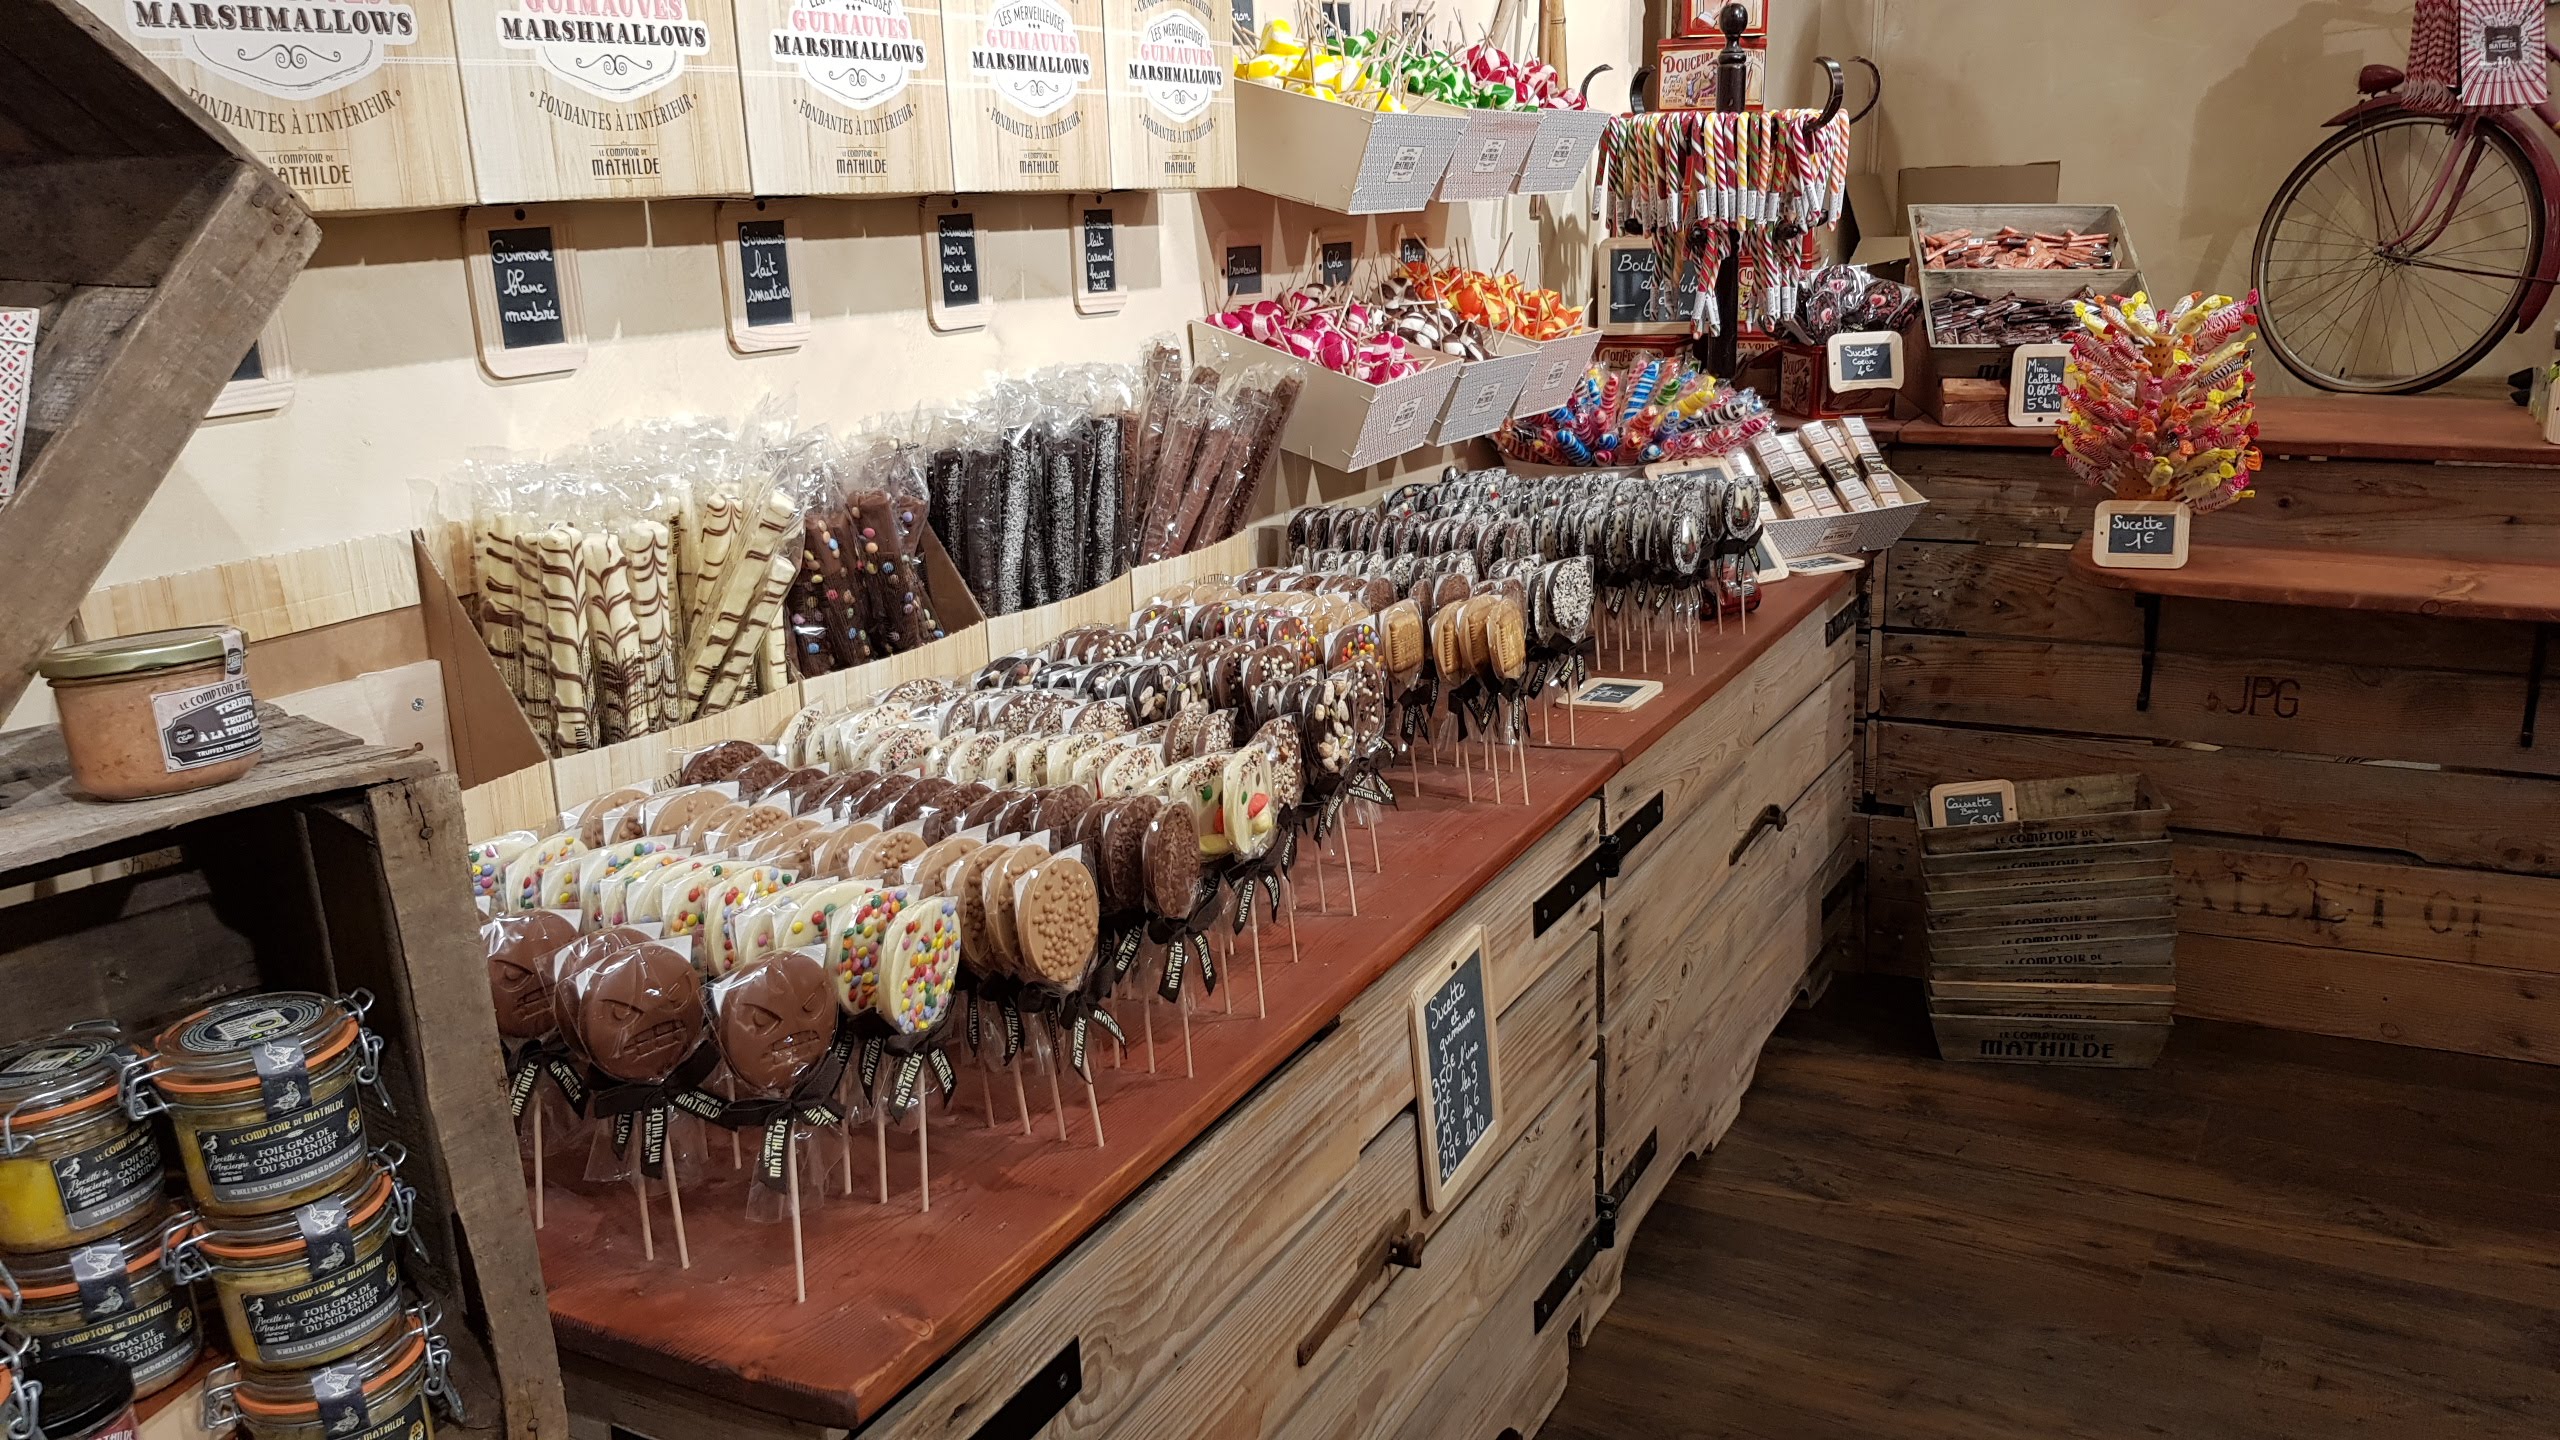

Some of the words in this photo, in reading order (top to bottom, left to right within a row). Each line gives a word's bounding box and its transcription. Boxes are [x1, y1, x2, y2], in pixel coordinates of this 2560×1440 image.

[136, 1, 413, 36] MARSHMALLOWS
[502, 17, 707, 47] MARSHMALLOWS
[793, 10, 908, 39] GUIMAUVES
[999, 10, 1012, 27] LES
[1013, 5, 1064, 33] MERVEILLEUSES
[774, 35, 924, 63] MARSHMALLOWS
[987, 29, 1077, 54] GUIMAUVES
[1151, 24, 1162, 42] LES
[1163, 23, 1203, 48] MERVEILLEUSES
[972, 51, 1089, 75] MARSHMALLOWS
[1141, 44, 1213, 67] GUIMAUVES
[1129, 64, 1222, 86] MARSHMALLOWS
[291, 107, 302, 135] À
[307, 89, 397, 135] L'INTÉRIEUR
[538, 91, 612, 131] FONDANTES
[616, 109, 623, 131] À
[627, 94, 693, 131] L'INTÉRIEUR
[799, 99, 853, 136] FONDANTES
[864, 103, 914, 136] L'INTÉRIEUR
[991, 107, 1033, 140] FONDANTES
[1041, 111, 1081, 140] L'INTÉRIEUR
[1143, 114, 1176, 143] FONDANTES
[278, 153, 323, 165] COMPTOIR
[592, 158, 660, 176] MATHILDE
[837, 159, 887, 174] MATHILDE
[1020, 161, 1059, 174] MATHILDE
[1165, 162, 1196, 174] MATHILDE
[271, 164, 352, 185] ATHILDE
[1087, 232, 1104, 247] lait
[750, 249, 778, 278] lait
[1326, 250, 1343, 269] Cola
[503, 269, 547, 296] blanc
[747, 278, 791, 303] smarties
[505, 299, 560, 323] marbré
[1844, 345, 1879, 357] Sucette
[1857, 365, 1874, 376] 4€
[2028, 358, 2048, 373] Mini
[2112, 514, 2167, 530] Sucette
[2125, 531, 2155, 549] 1€
[190, 683, 234, 707] COMPTOIR
[2226, 675, 2300, 718] JPG
[210, 730, 225, 740] LA
[1946, 796, 1993, 809] Caissette
[2010, 830, 2077, 844] COMPTOIR
[1116, 925, 1142, 971] MATHILDE
[1195, 934, 1213, 980] MATHILDE
[1169, 941, 1183, 989] MATHILDE
[1430, 981, 1466, 1030] Sucette
[1451, 1010, 1462, 1026] et
[1074, 1017, 1086, 1067] MATHILDE
[1439, 1008, 1476, 1066] guimauve
[1981, 1039, 2114, 1059] MATHILDE
[2013, 1031, 2079, 1041] COMPTOIR
[550, 1060, 581, 1104] MATHILDE
[895, 1051, 924, 1107] MATHILDE
[931, 1048, 953, 1093] MATHILDE
[1460, 1070, 1471, 1092] les
[1471, 1060, 1478, 1085] 3
[512, 1061, 539, 1116] MATHILDE
[1463, 1096, 1473, 1120] les
[1473, 1083, 1480, 1105] 6
[675, 1093, 720, 1119] MATHILD
[231, 1138, 239, 1146] LE
[240, 1120, 291, 1144] COMPTOIR
[303, 1098, 345, 1123] MATHILDE
[649, 1107, 664, 1163] MATHILDE
[1465, 1123, 1477, 1146] les
[1476, 1112, 1484, 1137] 10
[253, 1149, 303, 1168] CANARD
[304, 1131, 339, 1153] ENTIER
[258, 1144, 286, 1158] FOIE
[287, 1133, 315, 1151] GRAS
[316, 1126, 330, 1138] DE
[770, 1119, 788, 1178] MATHILDE
[260, 1163, 278, 1175] DU
[280, 1140, 337, 1173] SUD-OUEST
[121, 1175, 137, 1187] DU
[286, 1280, 336, 1304] COMPTOIR
[347, 1254, 384, 1282] MATHILDE
[300, 1308, 346, 1327] CANARD
[348, 1286, 380, 1310] ENTIER
[304, 1304, 331, 1318] FOIE
[331, 1293, 358, 1310] GRAS
[359, 1282, 371, 1296] DE
[62, 1323, 114, 1347] COMPTOIR
[127, 1300, 173, 1326] MATHILDE
[305, 1323, 322, 1335] DU
[324, 1295, 379, 1330] SUD-OUEST
[127, 1332, 167, 1356] ENTIER
[141, 1328, 156, 1341] DE
